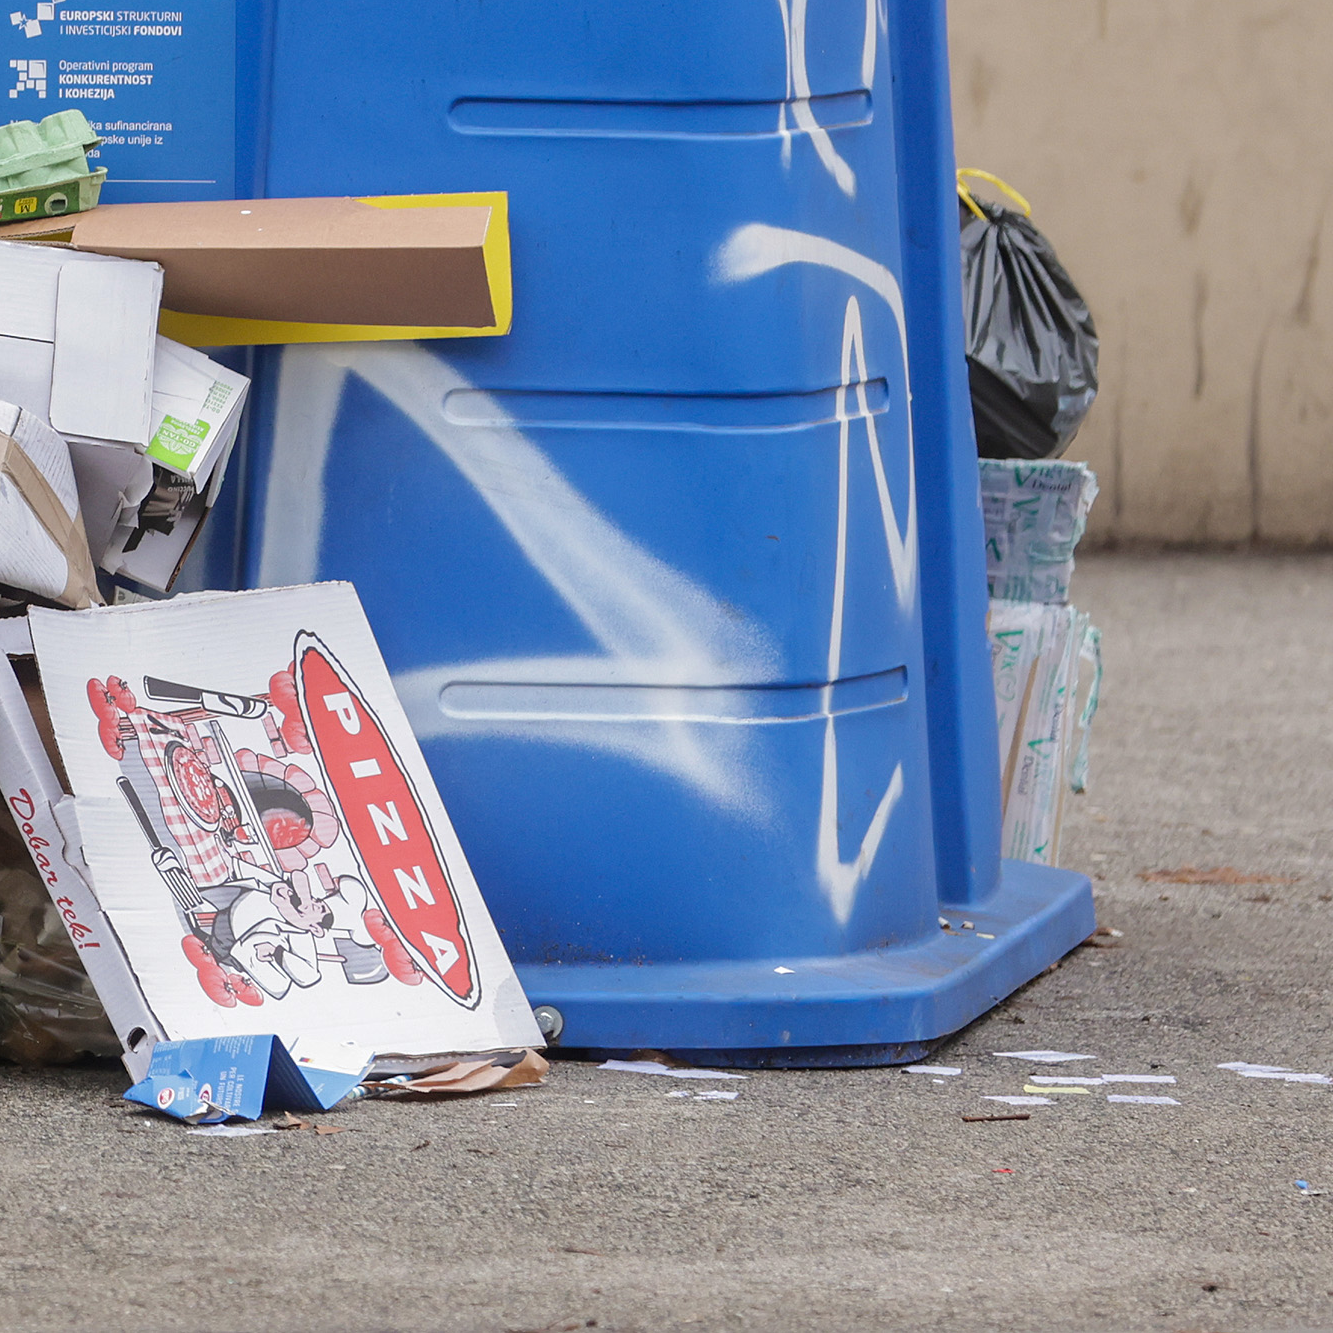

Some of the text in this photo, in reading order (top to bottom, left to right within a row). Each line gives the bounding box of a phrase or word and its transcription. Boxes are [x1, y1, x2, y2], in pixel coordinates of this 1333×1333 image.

[60, 11, 182, 22] EUROPSKI STRUKTURNI
[65, 25, 131, 37] INVESTICIJSKI
[133, 26, 182, 36] FONDOVI
[59, 60, 153, 72] Operativni program
[59, 75, 153, 85] KONKURENTNOST
[65, 89, 115, 100] KOHEZIJA
[105, 121, 172, 131] sufinancirana
[127, 135, 152, 146] unije
[154, 136, 163, 145] iz
[323, 691, 460, 976] PIZZA
[9, 788, 101, 951] Dobar tek!
